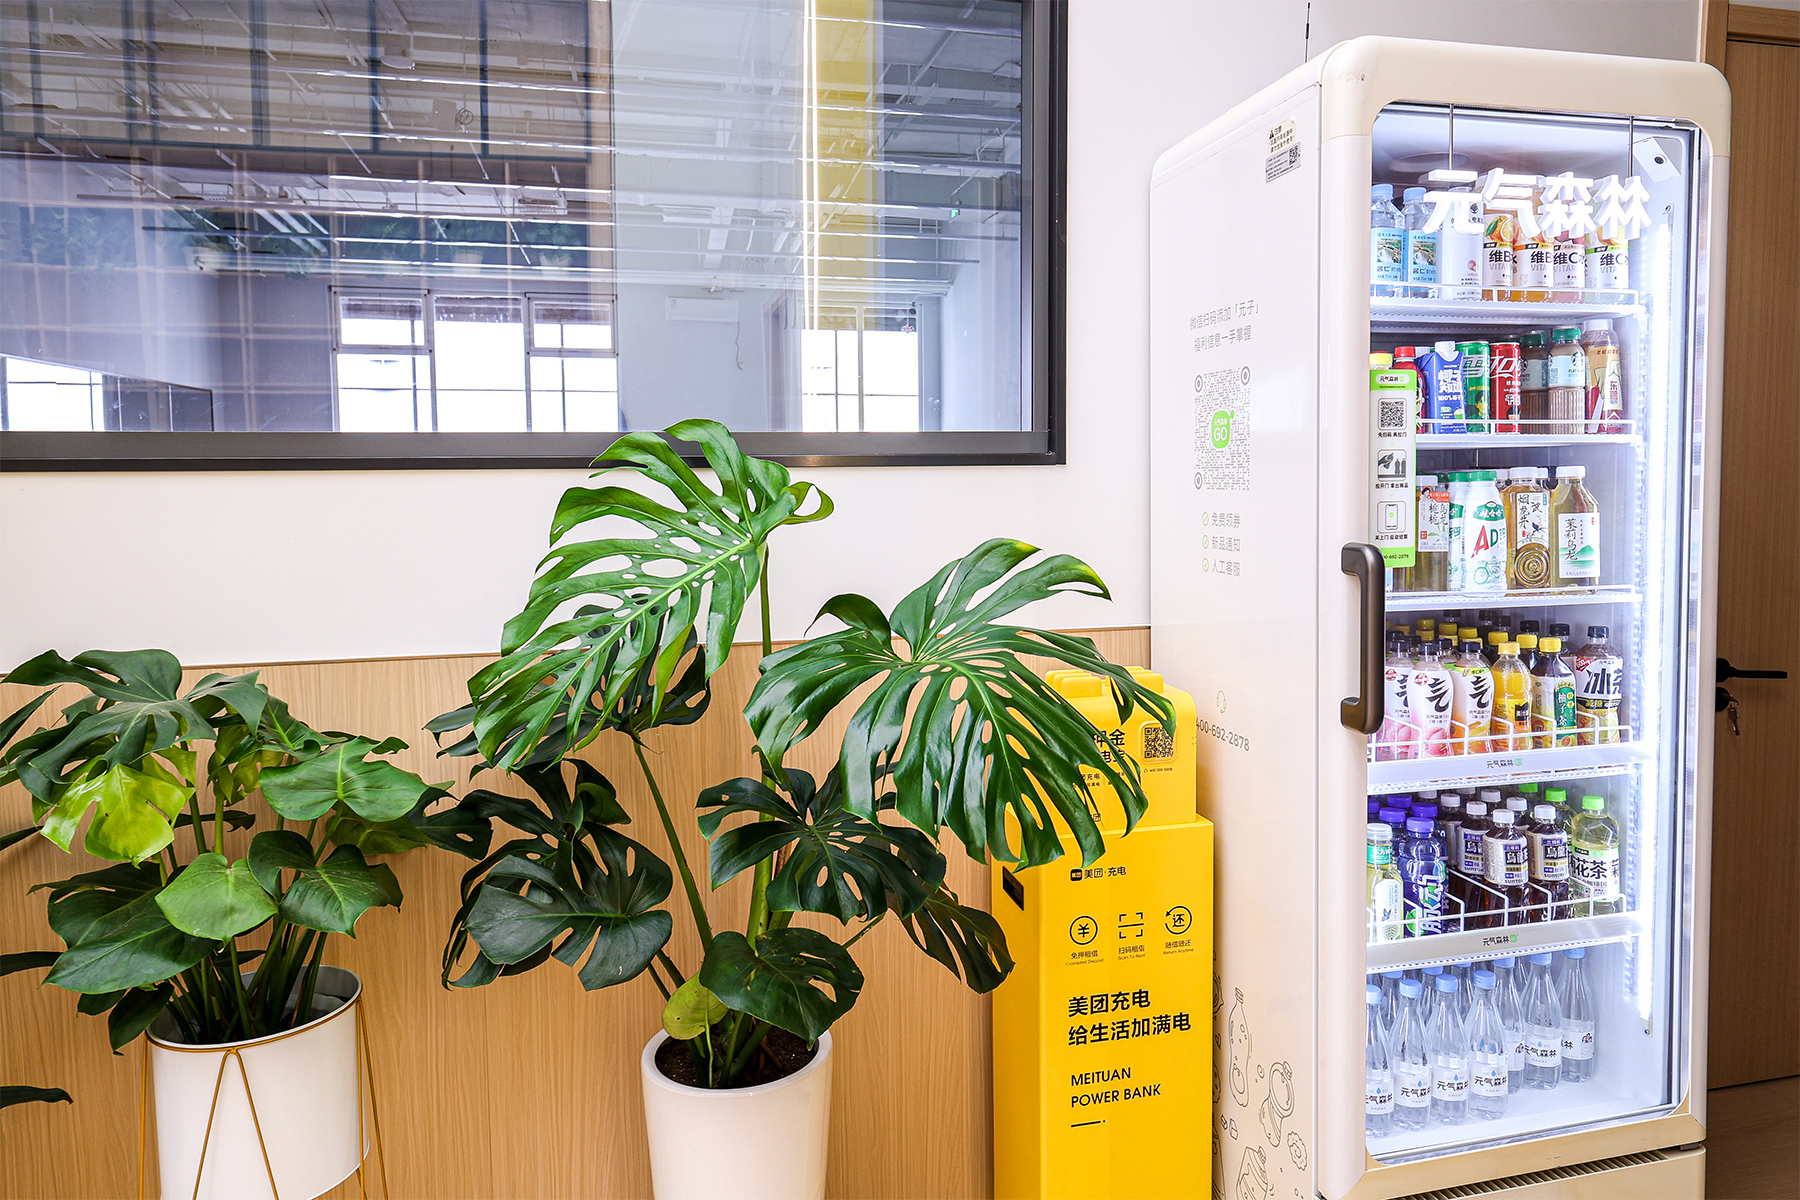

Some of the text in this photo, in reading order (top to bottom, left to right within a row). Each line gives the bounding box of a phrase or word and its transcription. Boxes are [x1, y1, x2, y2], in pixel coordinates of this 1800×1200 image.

[1422, 167, 1653, 241] 元气森林
[1194, 324, 1252, 352] 福利信息一手掌握
[1213, 426, 1228, 442] GO
[1211, 535, 1241, 552] 新品通知
[1211, 558, 1241, 577] 人工客服
[1196, 717, 1250, 752] 400-692-2878
[1486, 759, 1514, 769] 元气森林
[1118, 944, 1145, 955] 扫码租借
[1483, 936, 1510, 947] 元气森林
[1068, 988, 1151, 1018] 美团充电
[1068, 1012, 1192, 1046] 给生活加满电
[1071, 1067, 1131, 1087] MEITUAN
[1071, 1083, 1161, 1108] POWER BANK
